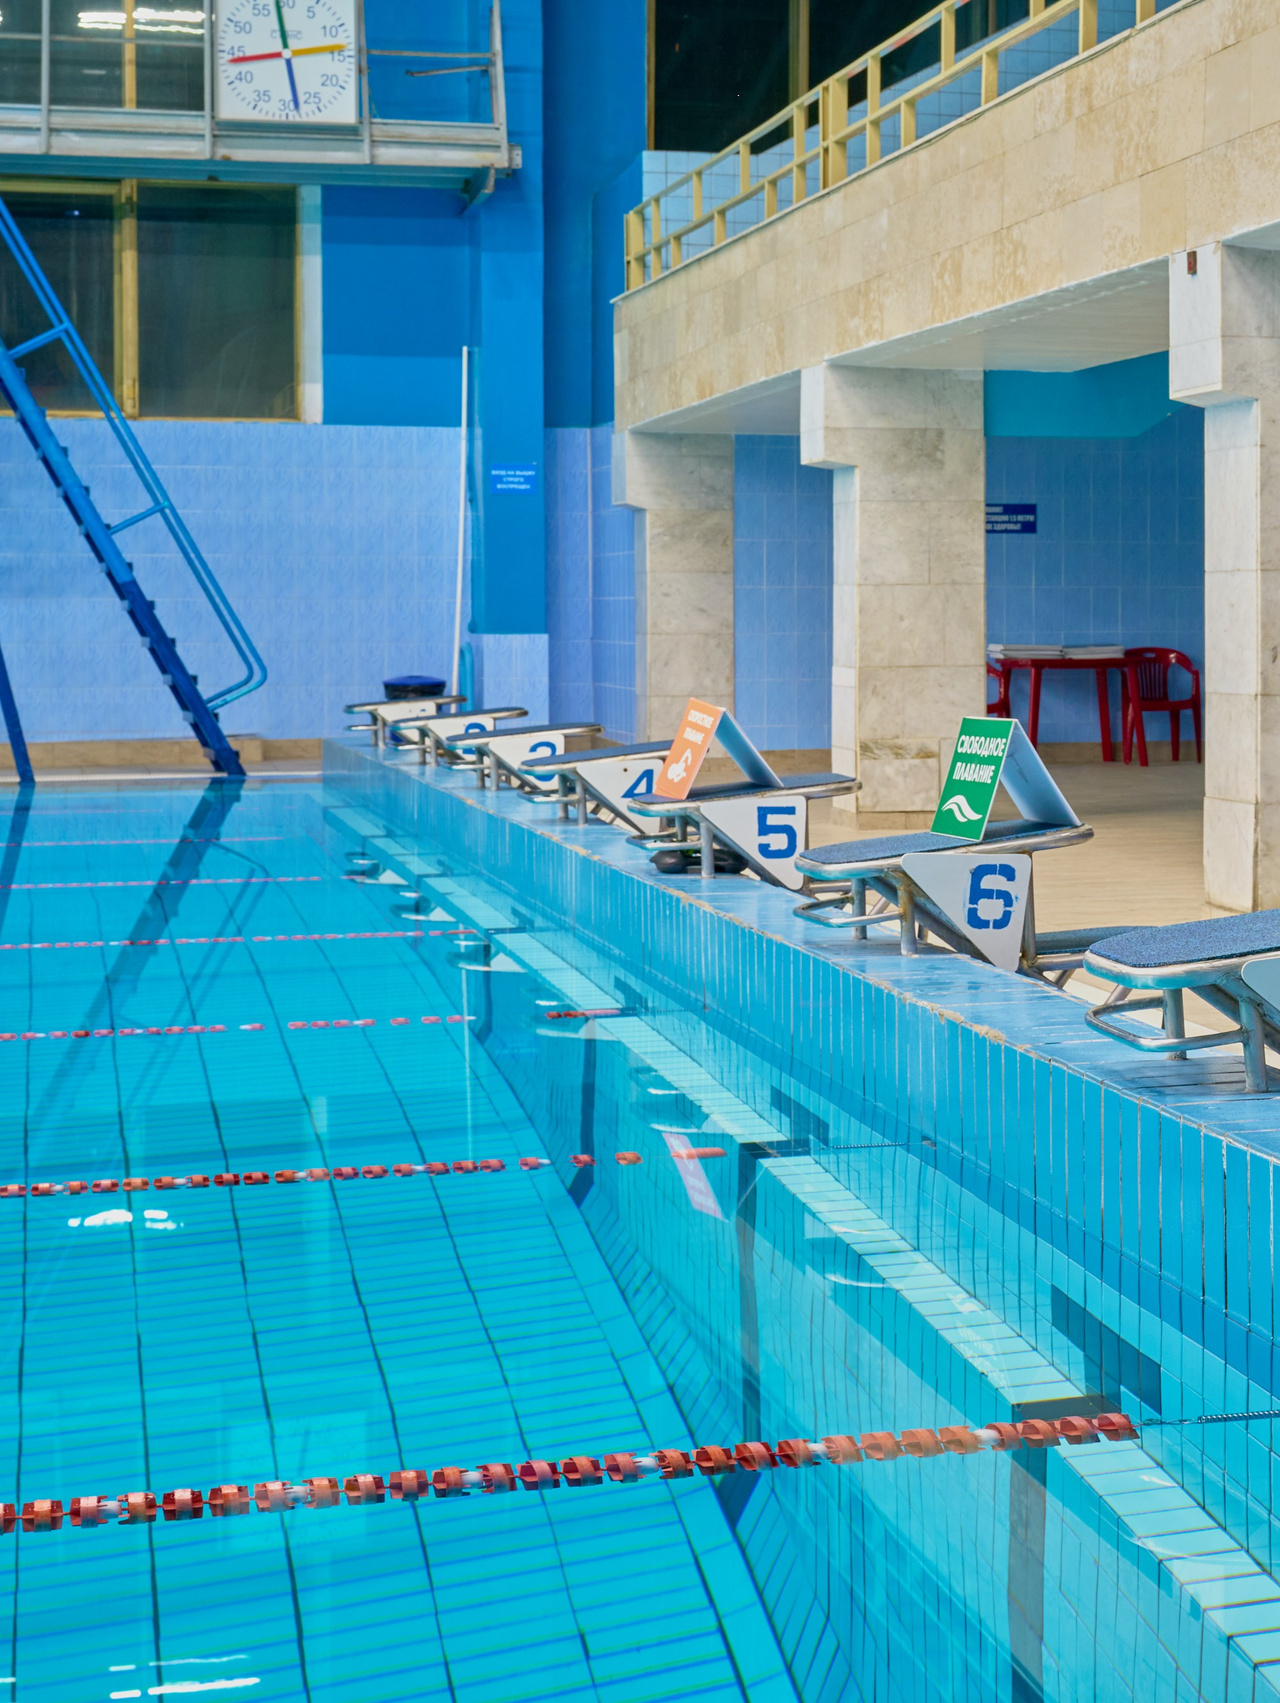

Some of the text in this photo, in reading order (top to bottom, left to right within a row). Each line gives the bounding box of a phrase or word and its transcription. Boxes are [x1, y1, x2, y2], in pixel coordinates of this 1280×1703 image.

[252, 4, 270, 17] 55
[306, 6, 316, 19] 5
[234, 21, 252, 34] 50
[321, 25, 338, 38] 10
[227, 45, 246, 58] 45
[330, 51, 346, 63] 15
[235, 71, 253, 84] 40
[321, 74, 339, 87] 20
[253, 90, 271, 103] 35
[304, 92, 322, 105] 25
[278, 99, 297, 112] 30
[957, 734, 1007, 758] СВОБОДНОЕ
[952, 761, 996, 784] ПЛАВАНИЕ
[621, 768, 654, 799] 4
[756, 805, 797, 859] 5
[966, 863, 1016, 930] 6
